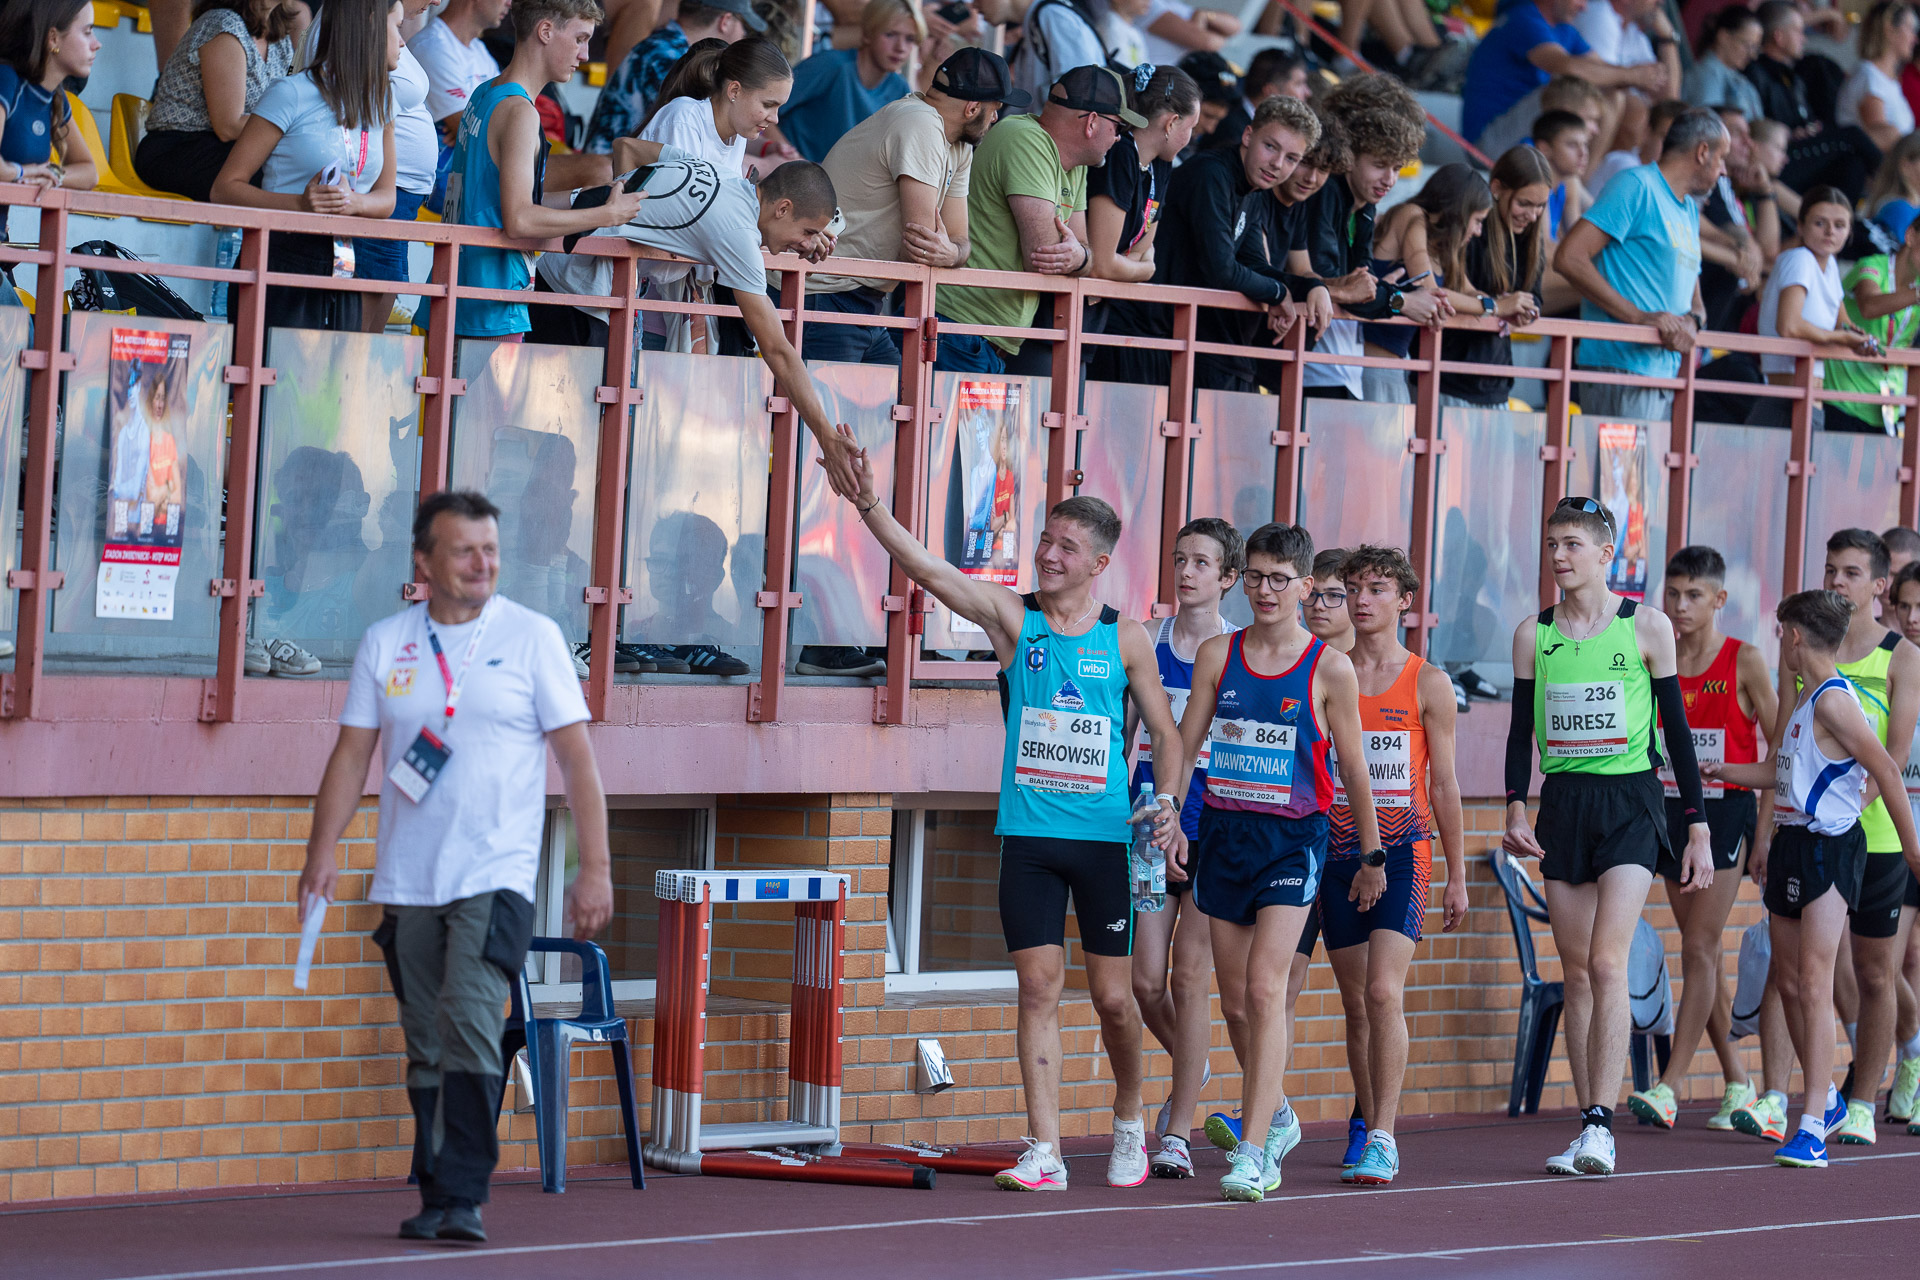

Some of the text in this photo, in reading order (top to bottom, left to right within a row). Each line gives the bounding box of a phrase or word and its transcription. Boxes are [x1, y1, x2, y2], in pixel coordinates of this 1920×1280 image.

[1086, 648, 1109, 656] CUBE
[1082, 664, 1106, 674] wibo
[1584, 685, 1617, 702] 236
[1070, 718, 1103, 736] 681
[1551, 712, 1617, 731] BURESZ
[1255, 728, 1288, 745] 864
[1370, 735, 1402, 751] 894
[1021, 740, 1106, 767] SERKOWSKI
[1557, 747, 1594, 755] BIAŁYSTOK
[1214, 750, 1290, 776] WAWRZYNIAK
[1029, 777, 1070, 789] BIAŁYSTOK
[1070, 783, 1090, 791] 2024
[1219, 788, 1255, 799] BIAŁYSTOK
[1256, 792, 1275, 801] 2024
